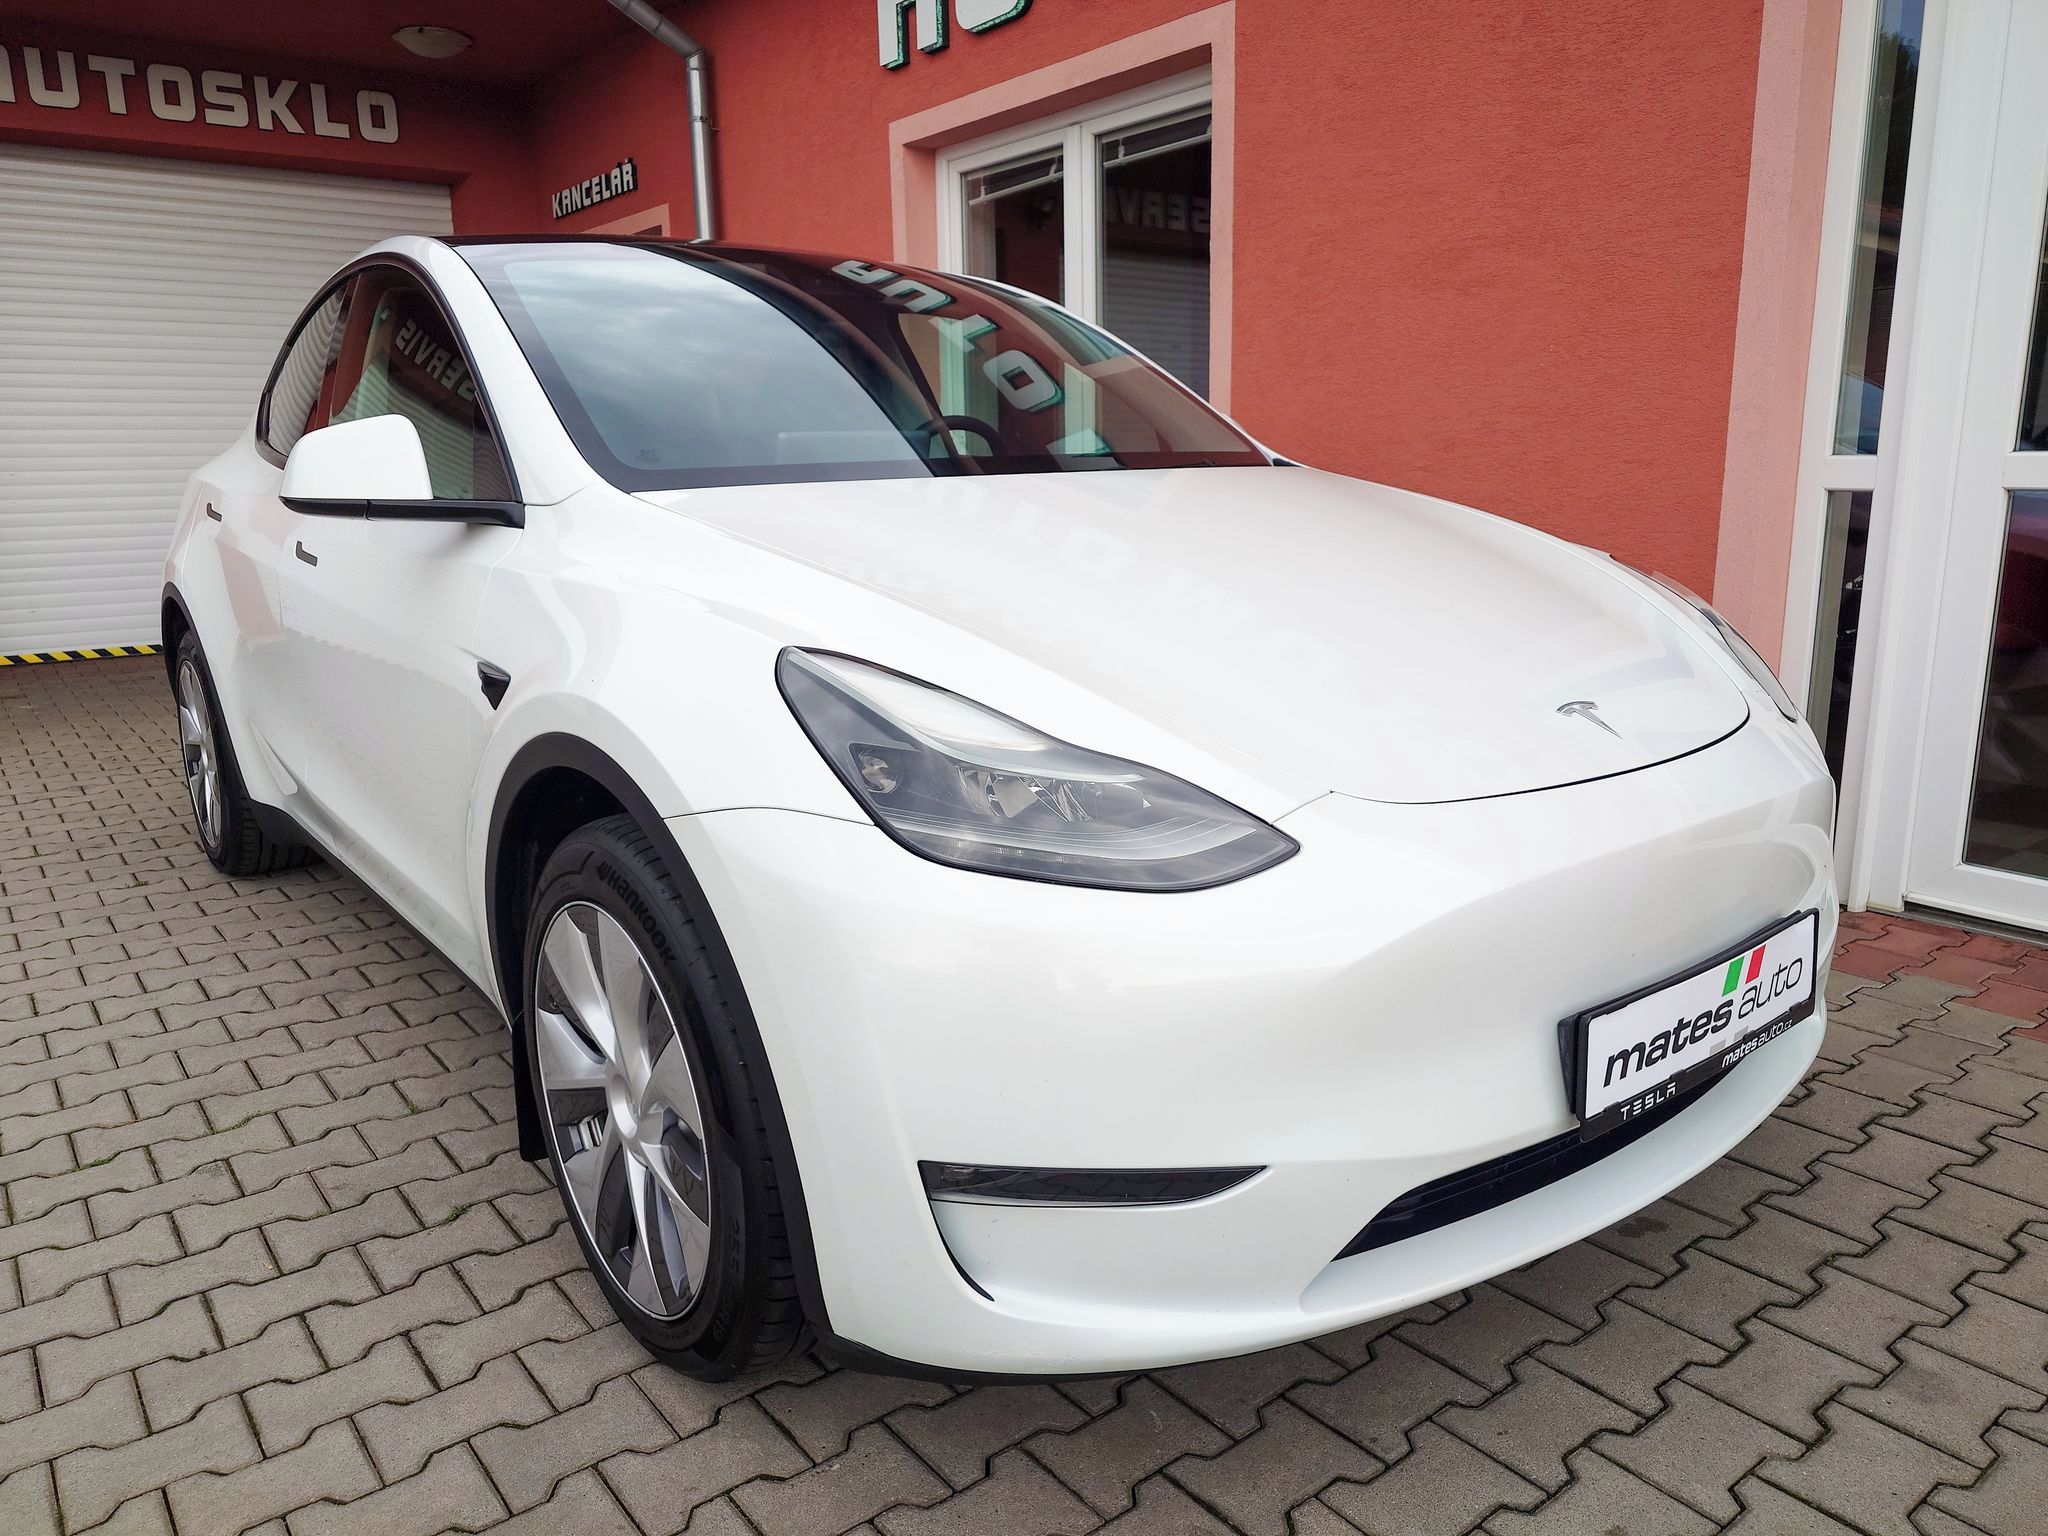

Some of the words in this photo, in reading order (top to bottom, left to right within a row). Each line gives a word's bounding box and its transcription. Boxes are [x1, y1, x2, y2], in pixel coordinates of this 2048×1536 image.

[1603, 999, 1734, 1088] mates
[1738, 957, 1803, 1020] auto
[1620, 1081, 1677, 1121] TESLA
